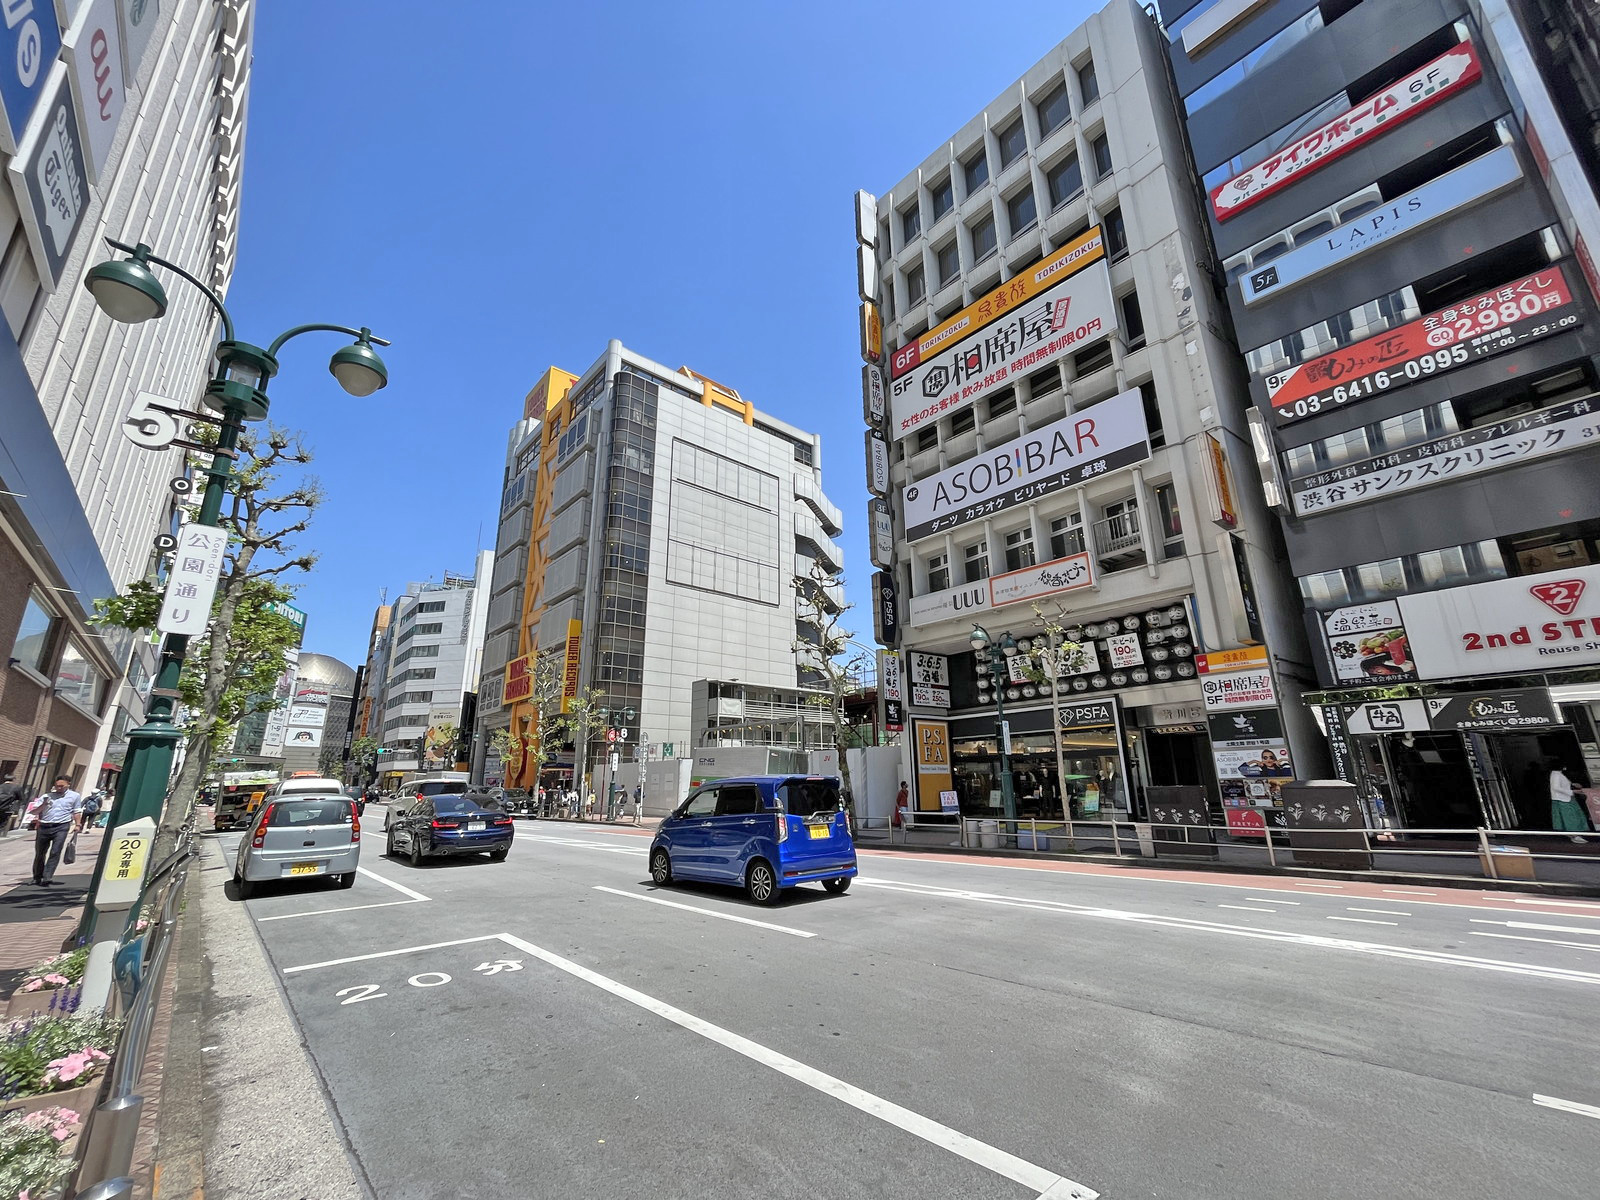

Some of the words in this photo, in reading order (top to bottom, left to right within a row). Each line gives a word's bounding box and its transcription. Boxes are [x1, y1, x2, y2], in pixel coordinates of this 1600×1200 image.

[91, 28, 112, 121] au
[1263, 94, 1398, 180] アイワホーム
[1408, 68, 1440, 94] 6F
[45, 150, 71, 220] Tiger
[1327, 197, 1422, 251] LAPIS
[1037, 241, 1095, 280] TORIKIZOKU
[1255, 274, 1275, 290] 5F
[1423, 277, 1552, 332] 全身もみほぐし
[921, 322, 964, 352] TORIKIZOKU
[951, 301, 1060, 387] 相席屋
[896, 348, 915, 370] 6F
[894, 376, 913, 396] 5F
[901, 391, 960, 430] 女性のお客様
[961, 368, 1008, 398] 飲み放題
[1268, 376, 1288, 390] 9F
[1295, 344, 1469, 418] 03-6416-0995
[122, 390, 180, 449] 5
[874, 443, 883, 486] ASOBIBAR
[932, 418, 1100, 512] ASOBIBAR
[1302, 427, 1567, 511] 渋谷サンクスクリニック
[908, 489, 919, 500] 4F
[931, 516, 958, 532] ダーツ
[965, 497, 1005, 520] カラオケ
[1014, 474, 1070, 501] ビリヤード
[1081, 460, 1107, 478] 卓球
[172, 533, 211, 624] 公園通り
[204, 536, 224, 582] Koen-dori
[886, 601, 894, 626] PSFA
[953, 587, 985, 611] UUU
[567, 636, 579, 661] TOWER
[1462, 627, 1532, 651] 2nd
[1538, 645, 1580, 656] Reuse
[564, 663, 578, 697] RECORDS
[1207, 695, 1223, 705] 5F
[1075, 705, 1110, 720] PSFA
